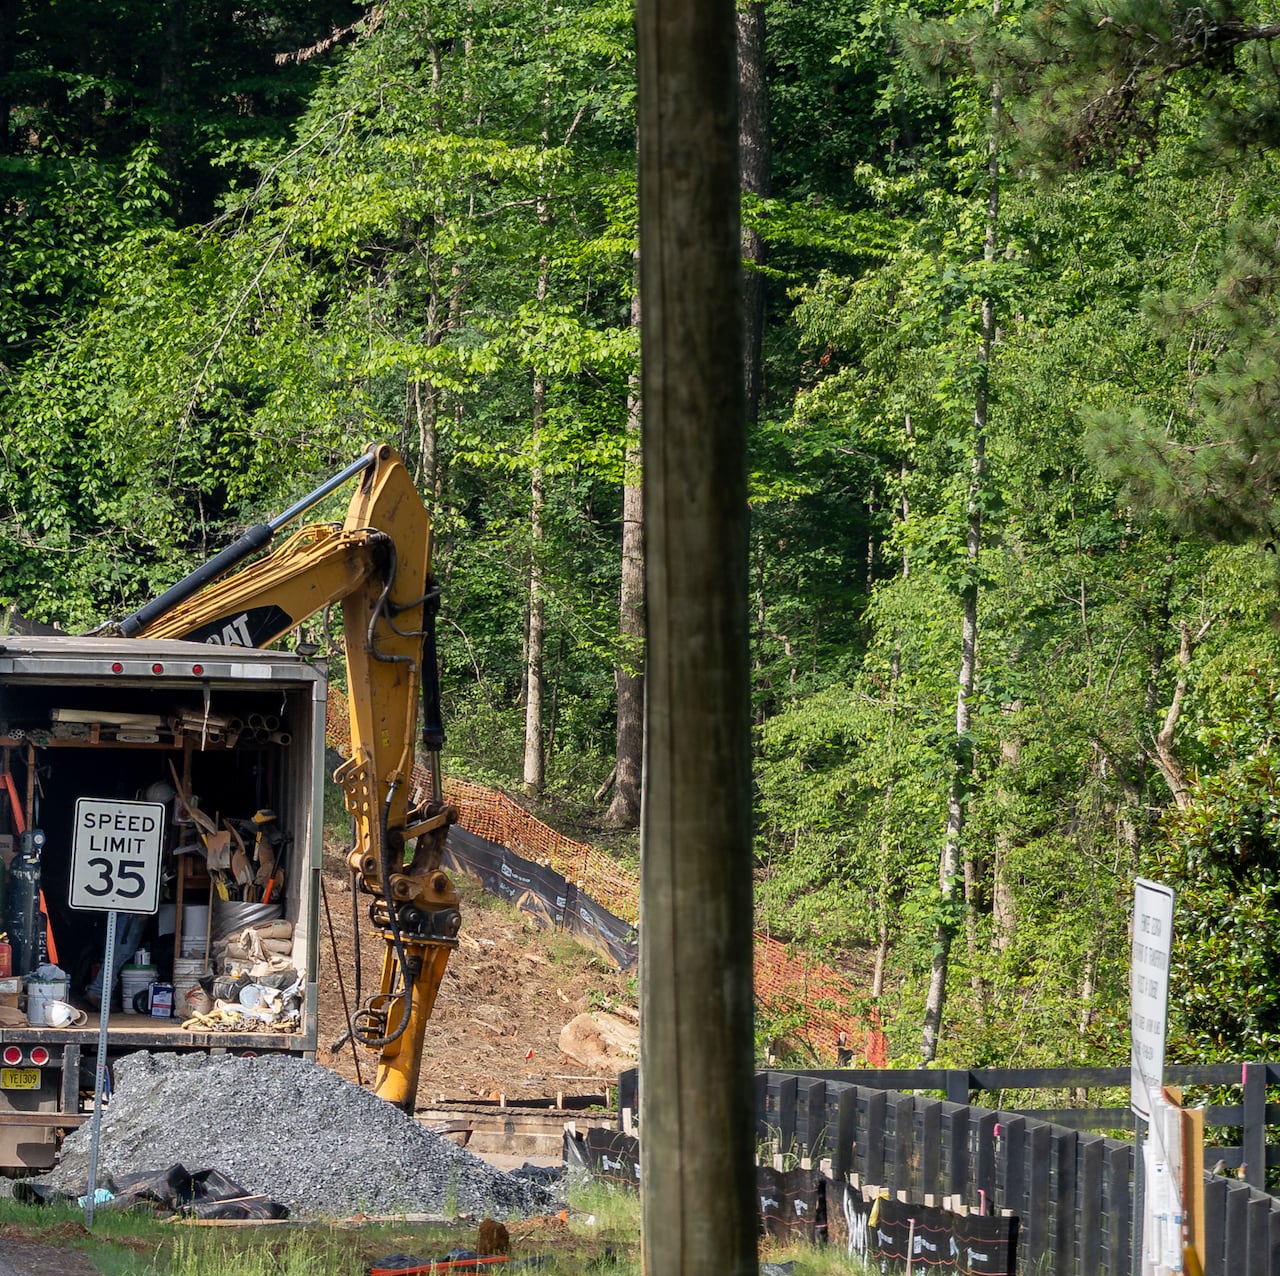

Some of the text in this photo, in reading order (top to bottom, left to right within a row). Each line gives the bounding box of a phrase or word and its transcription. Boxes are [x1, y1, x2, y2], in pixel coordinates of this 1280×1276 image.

[83, 812, 155, 832] SPEED
[89, 835, 146, 854] LIMIT
[83, 857, 146, 899] 35
